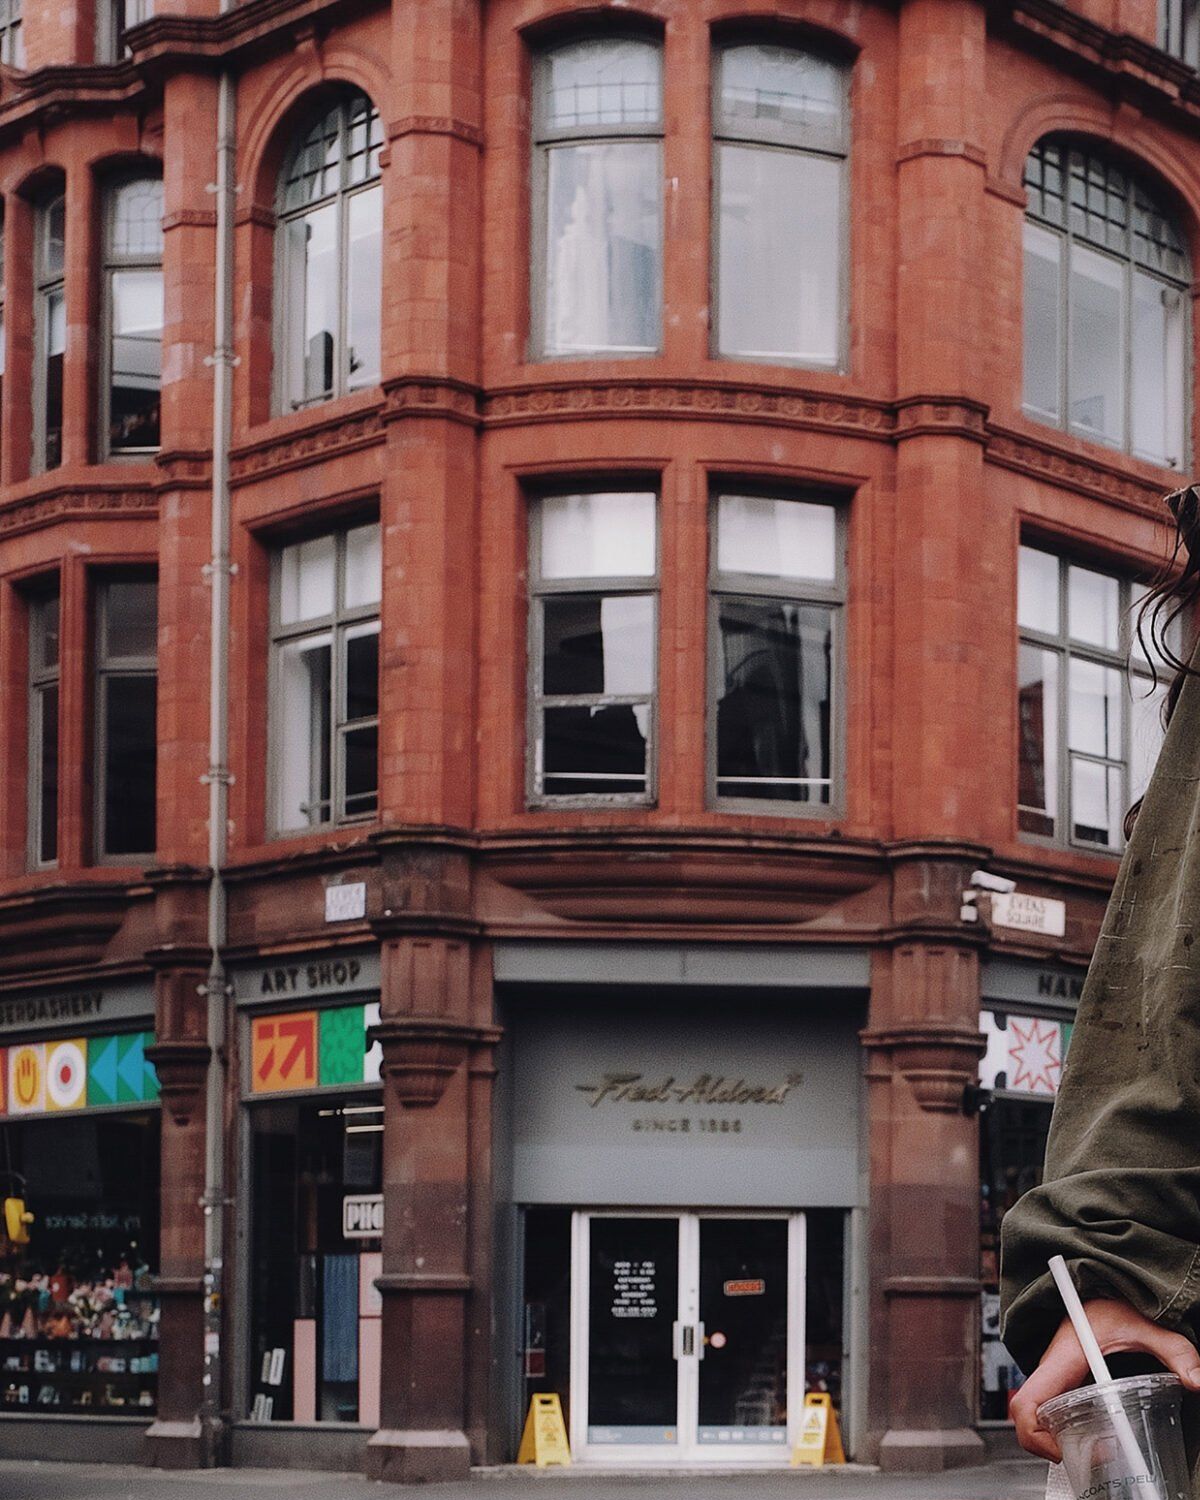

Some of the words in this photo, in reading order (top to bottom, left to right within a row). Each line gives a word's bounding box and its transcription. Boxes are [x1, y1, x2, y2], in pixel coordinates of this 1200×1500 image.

[261, 966, 299, 994] ART
[306, 960, 360, 988] SHOP
[632, 1118, 690, 1133] SINCE
